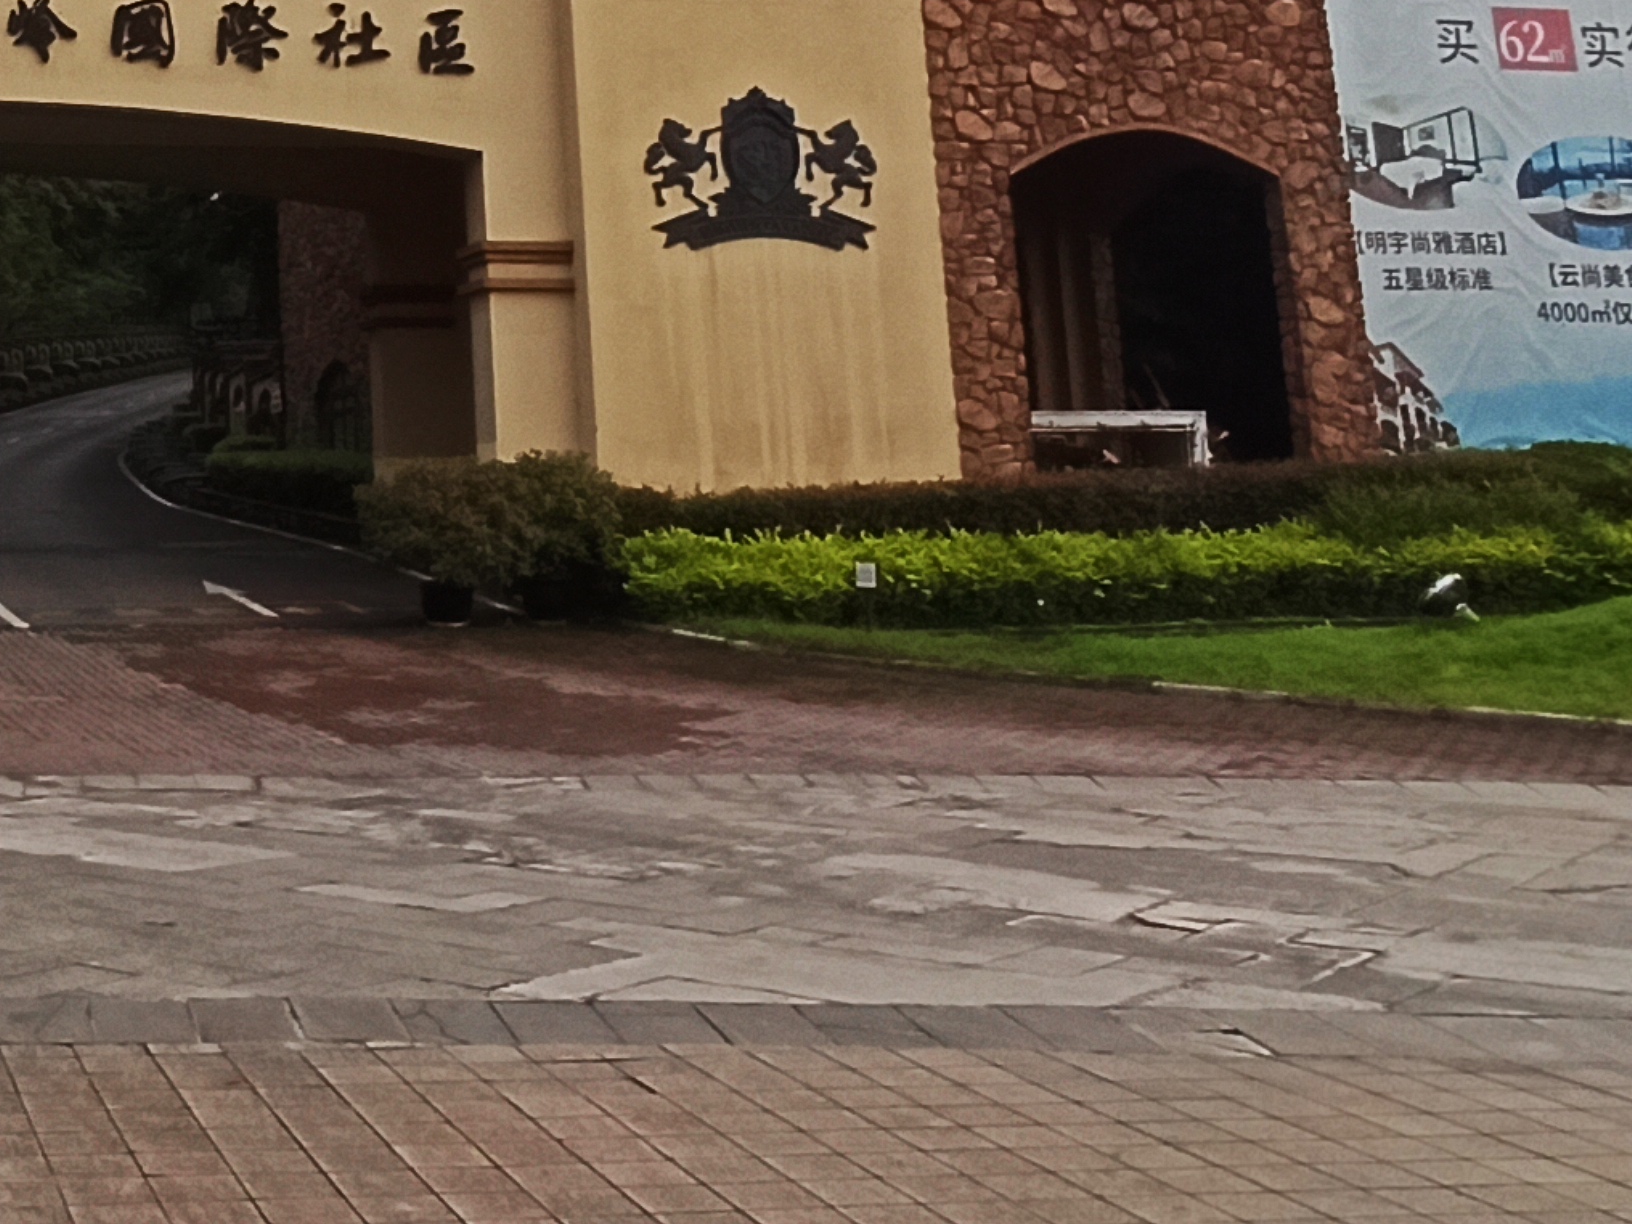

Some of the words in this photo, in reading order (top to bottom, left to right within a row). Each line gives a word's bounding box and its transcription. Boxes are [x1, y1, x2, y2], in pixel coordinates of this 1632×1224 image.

[1382, 266, 1494, 291] 五星级标准
